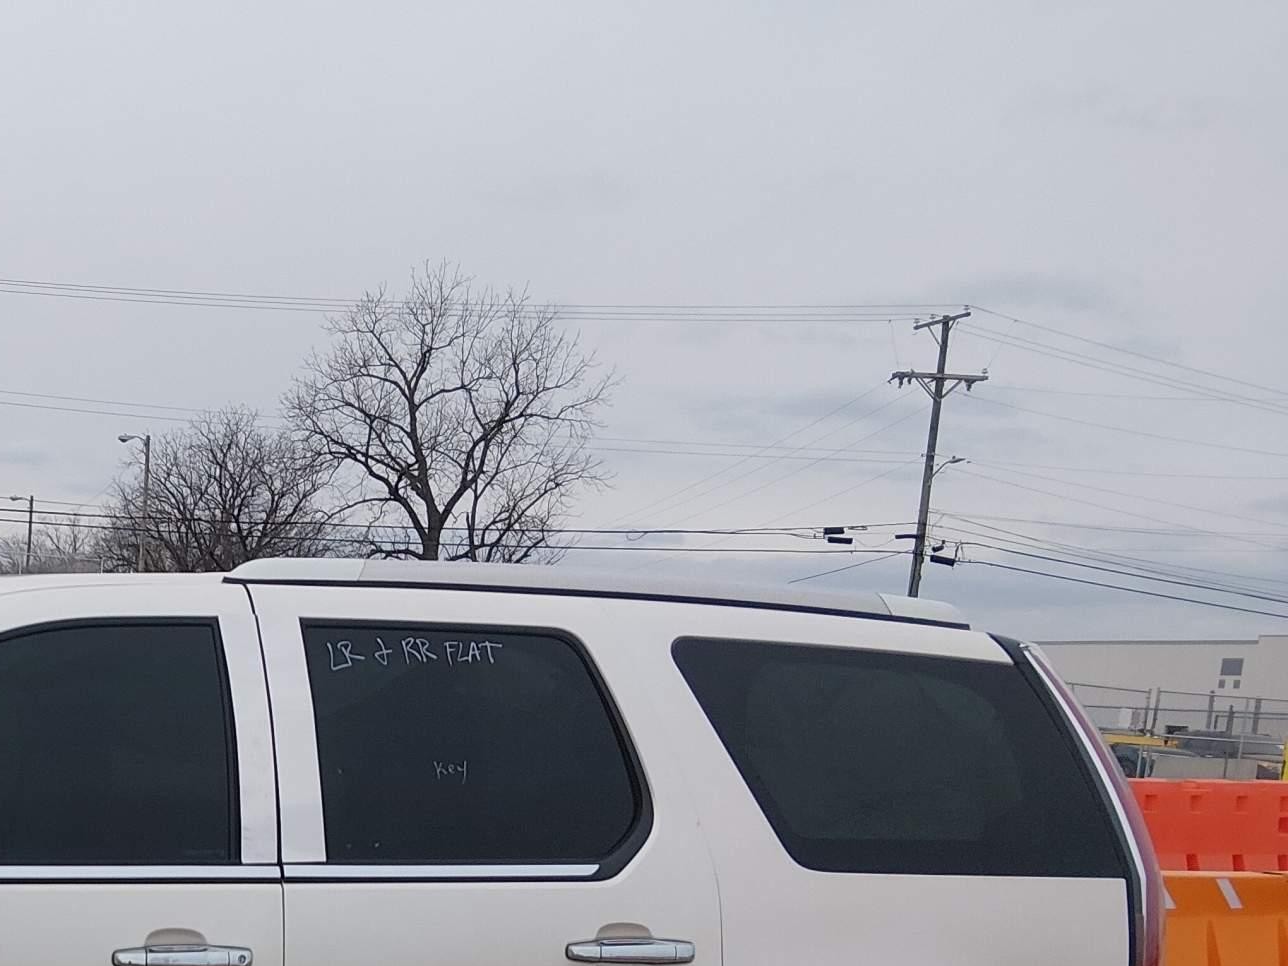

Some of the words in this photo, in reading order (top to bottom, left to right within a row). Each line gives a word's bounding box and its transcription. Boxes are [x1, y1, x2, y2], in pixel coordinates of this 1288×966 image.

[326, 640, 366, 671] LR
[401, 637, 438, 665] RR
[443, 640, 503, 667] FLAT
